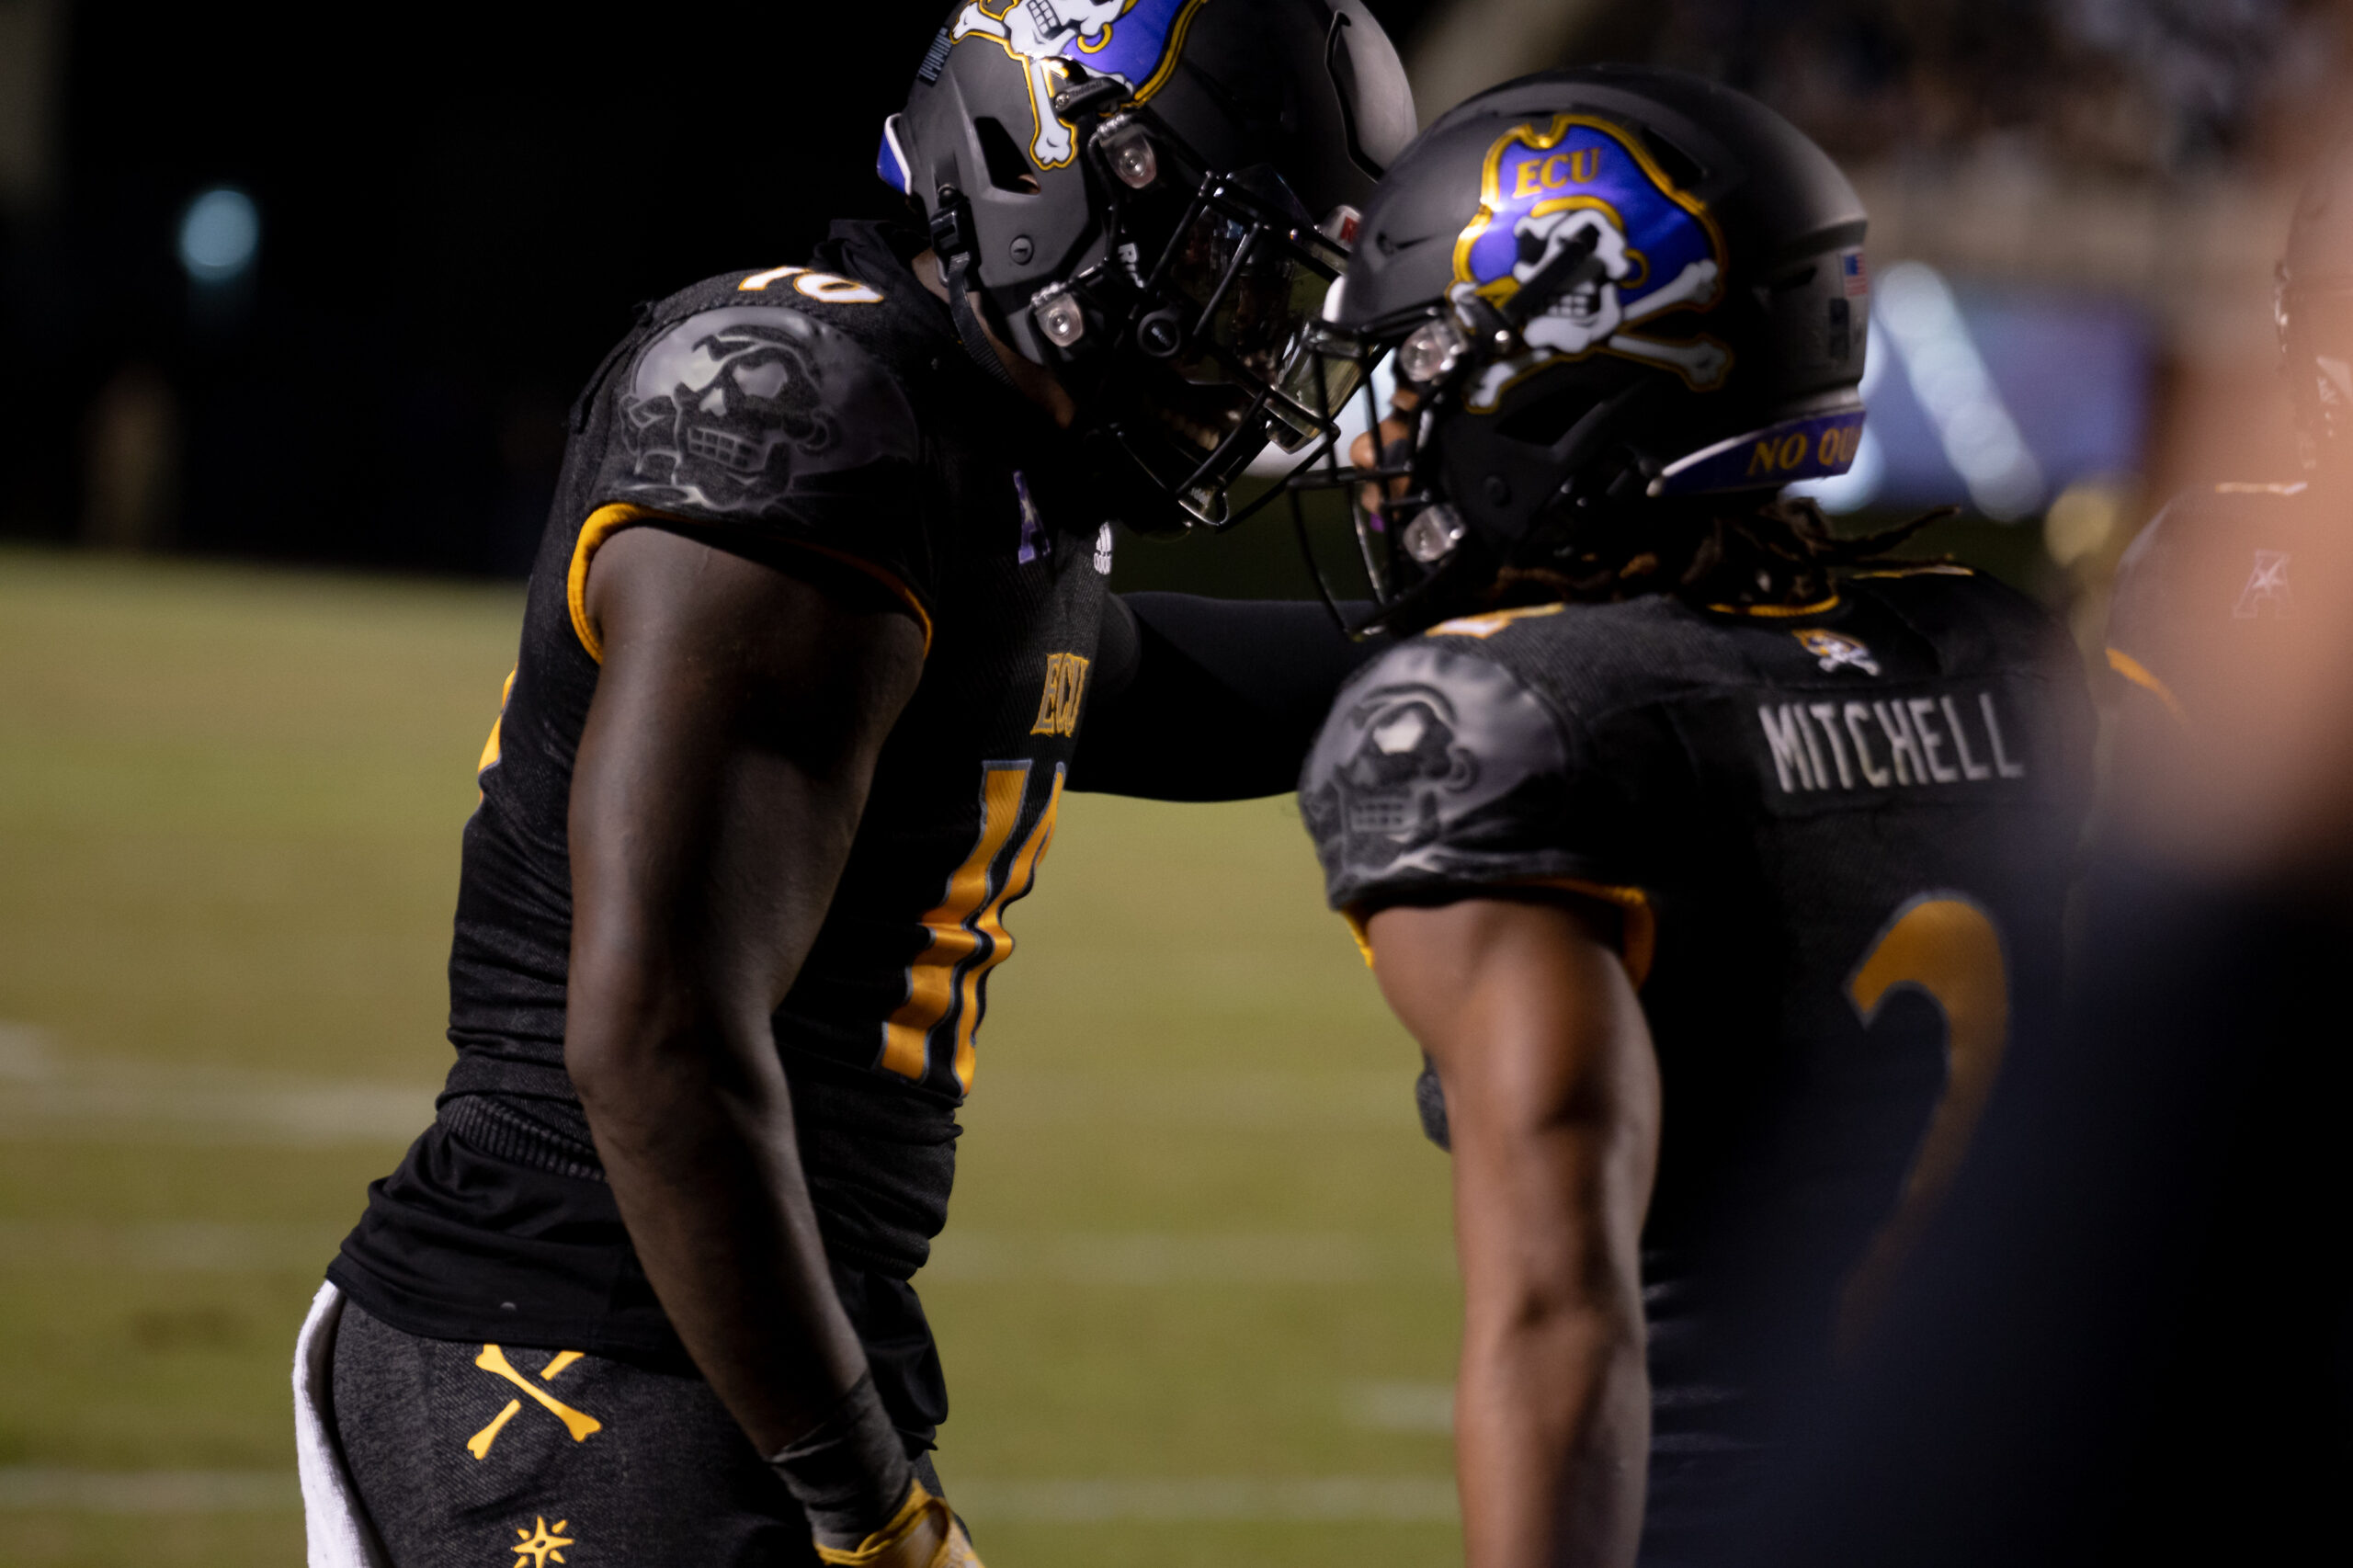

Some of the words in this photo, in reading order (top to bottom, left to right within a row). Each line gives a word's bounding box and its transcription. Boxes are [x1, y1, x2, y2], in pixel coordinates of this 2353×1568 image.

[1512, 146, 1602, 199] ECU
[1747, 432, 1807, 476] NO
[1029, 653, 1090, 737] ECU
[1758, 692, 2023, 793] MITCHELL
